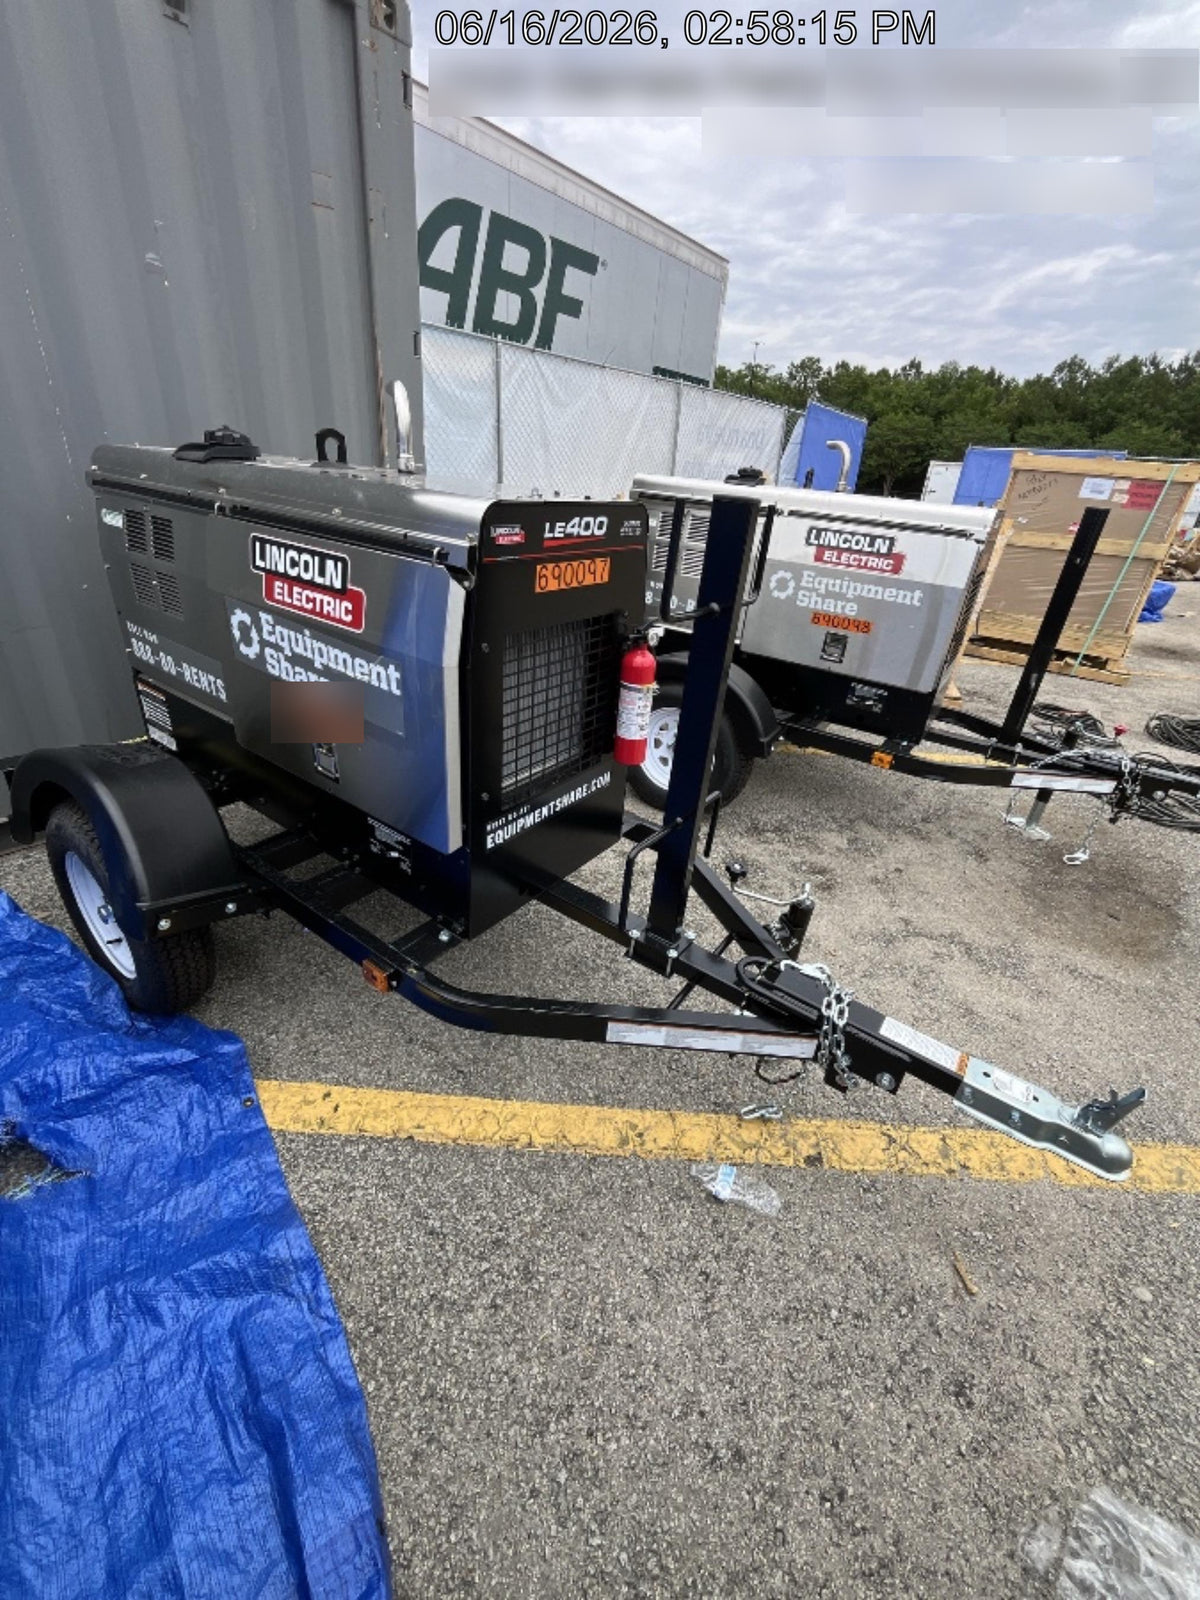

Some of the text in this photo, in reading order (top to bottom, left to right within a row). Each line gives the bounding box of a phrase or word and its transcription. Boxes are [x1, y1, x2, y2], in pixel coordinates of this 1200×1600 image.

[417, 197, 601, 352] ABF
[544, 516, 609, 538] LE400
[808, 530, 890, 554] LINCOLN
[253, 540, 343, 590] LINCOLN
[538, 558, 609, 591] 690097
[823, 550, 895, 571] ELECTRIC
[272, 582, 354, 623] ELECTRIC
[795, 591, 859, 616] Share
[800, 570, 924, 607] Equipment
[257, 611, 404, 696] Equipment
[486, 771, 611, 849] EQUIPMENTSHARE.COM
